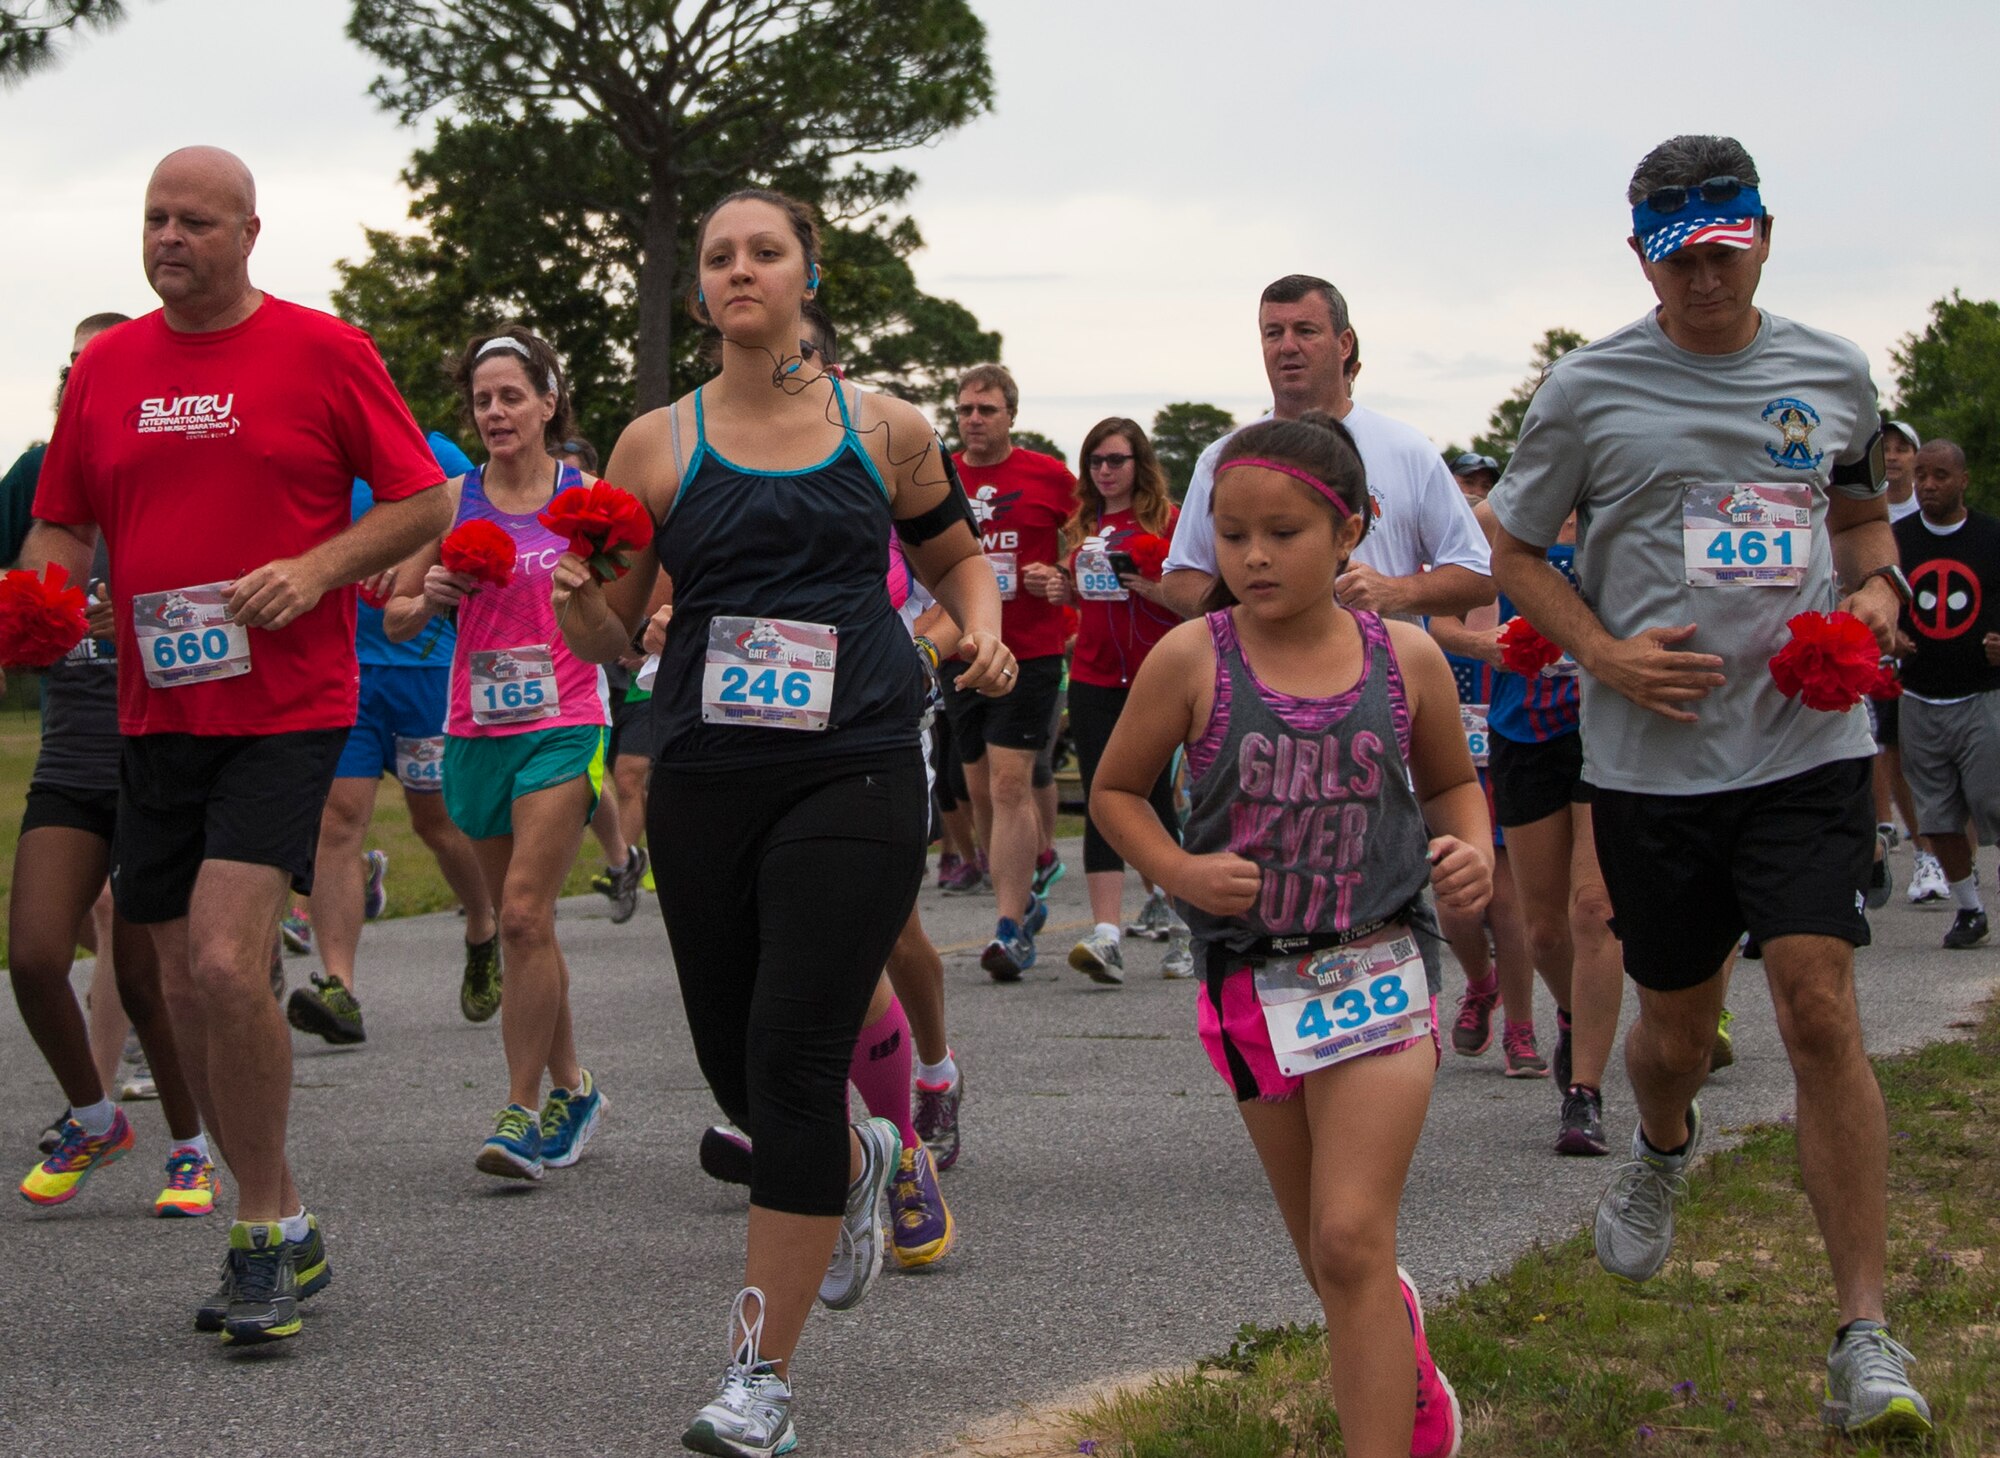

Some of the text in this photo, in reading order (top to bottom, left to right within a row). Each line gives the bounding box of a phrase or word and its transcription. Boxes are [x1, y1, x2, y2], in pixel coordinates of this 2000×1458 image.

[139, 414, 216, 427] INTERNATIONAL
[164, 424, 187, 432] MUSIC
[187, 422, 229, 430] MARATHON
[1732, 512, 1751, 523] GATE
[1706, 530, 1793, 566] 461
[153, 628, 229, 669] 660
[748, 649, 768, 660] GATE
[483, 679, 544, 710] 165
[719, 666, 812, 708] 246
[1239, 730, 1384, 801] GIRLS
[1228, 802, 1369, 869] NEVER
[1259, 868, 1363, 931] UIT
[1317, 969, 1342, 986] GATE
[1295, 974, 1409, 1039] 438
